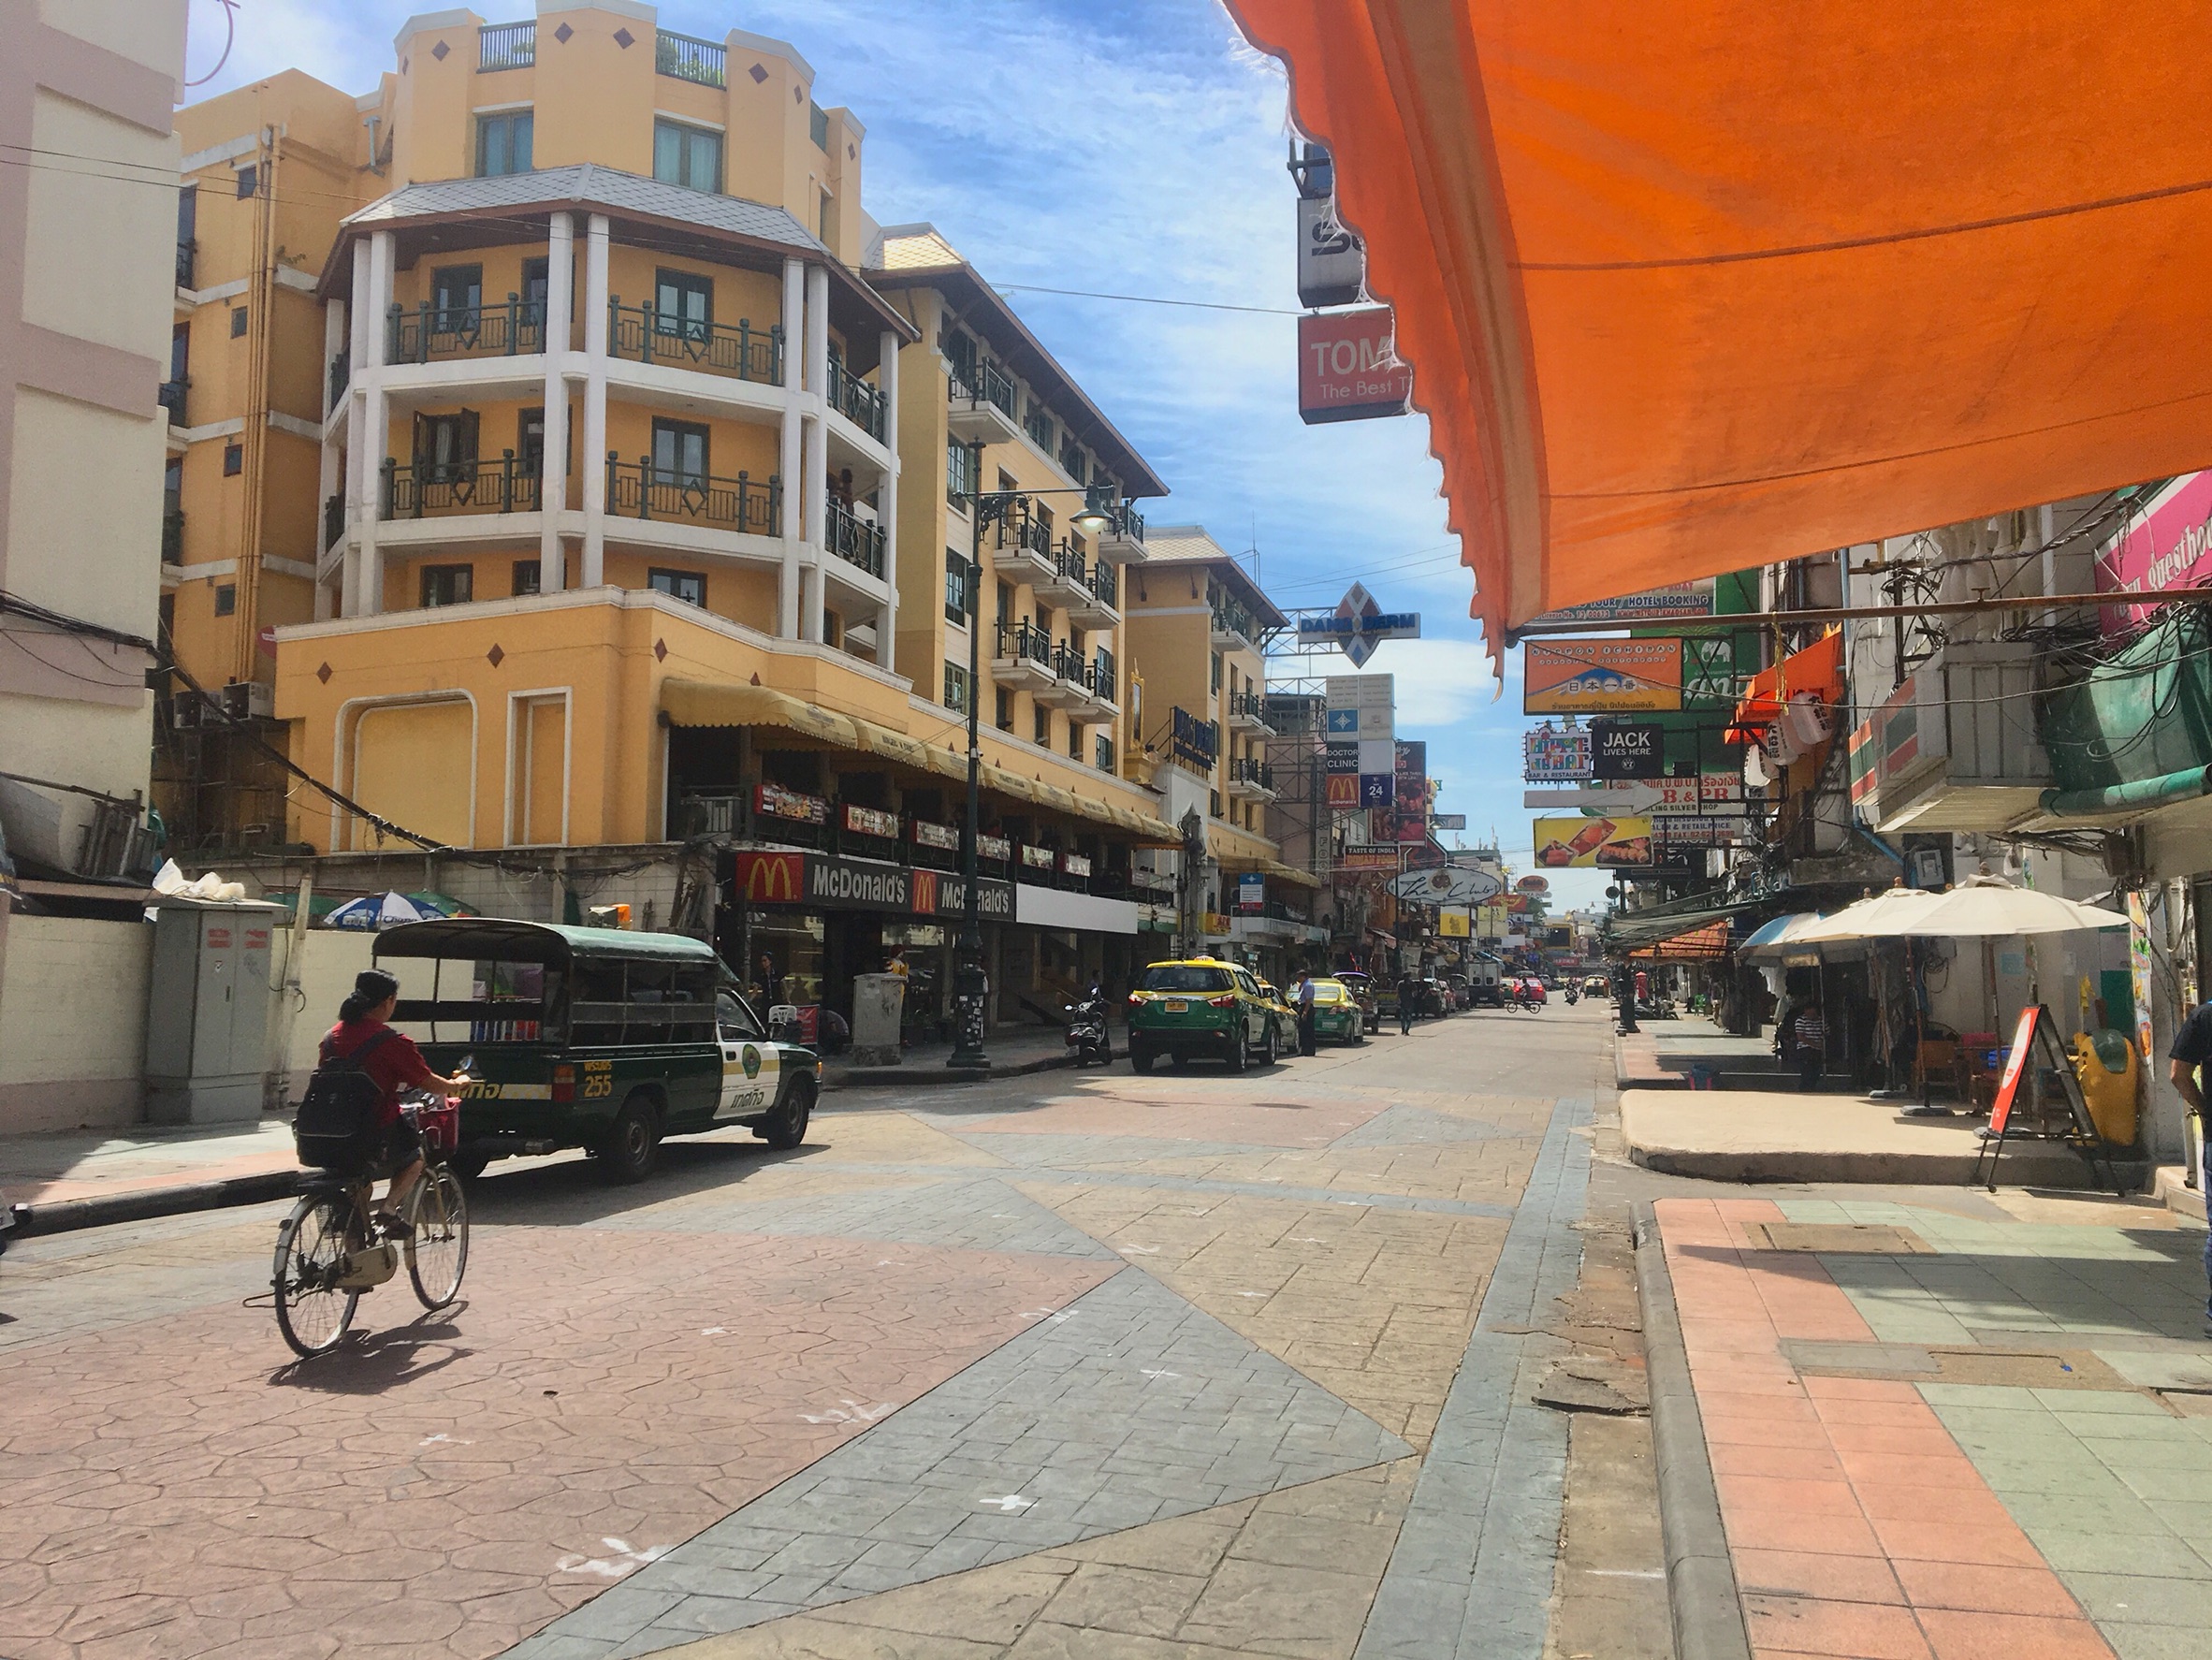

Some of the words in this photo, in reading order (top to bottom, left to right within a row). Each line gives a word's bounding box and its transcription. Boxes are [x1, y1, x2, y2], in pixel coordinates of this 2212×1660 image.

[1320, 383, 1351, 400] The
[1357, 379, 1394, 397] Best
[1628, 595, 1659, 607] HOTEL
[1662, 594, 1710, 606] BOOKING
[1603, 644, 1676, 654] ICHIBAN
[1603, 732, 1651, 748] JACK
[1327, 760, 1359, 768] CLINIC
[1369, 786, 1383, 796] 24
[813, 865, 907, 904] McDonald's
[1400, 875, 1433, 898] The
[1448, 881, 1492, 898] Club
[941, 881, 1010, 914] Mcnald's
[584, 1074, 612, 1098] 255
